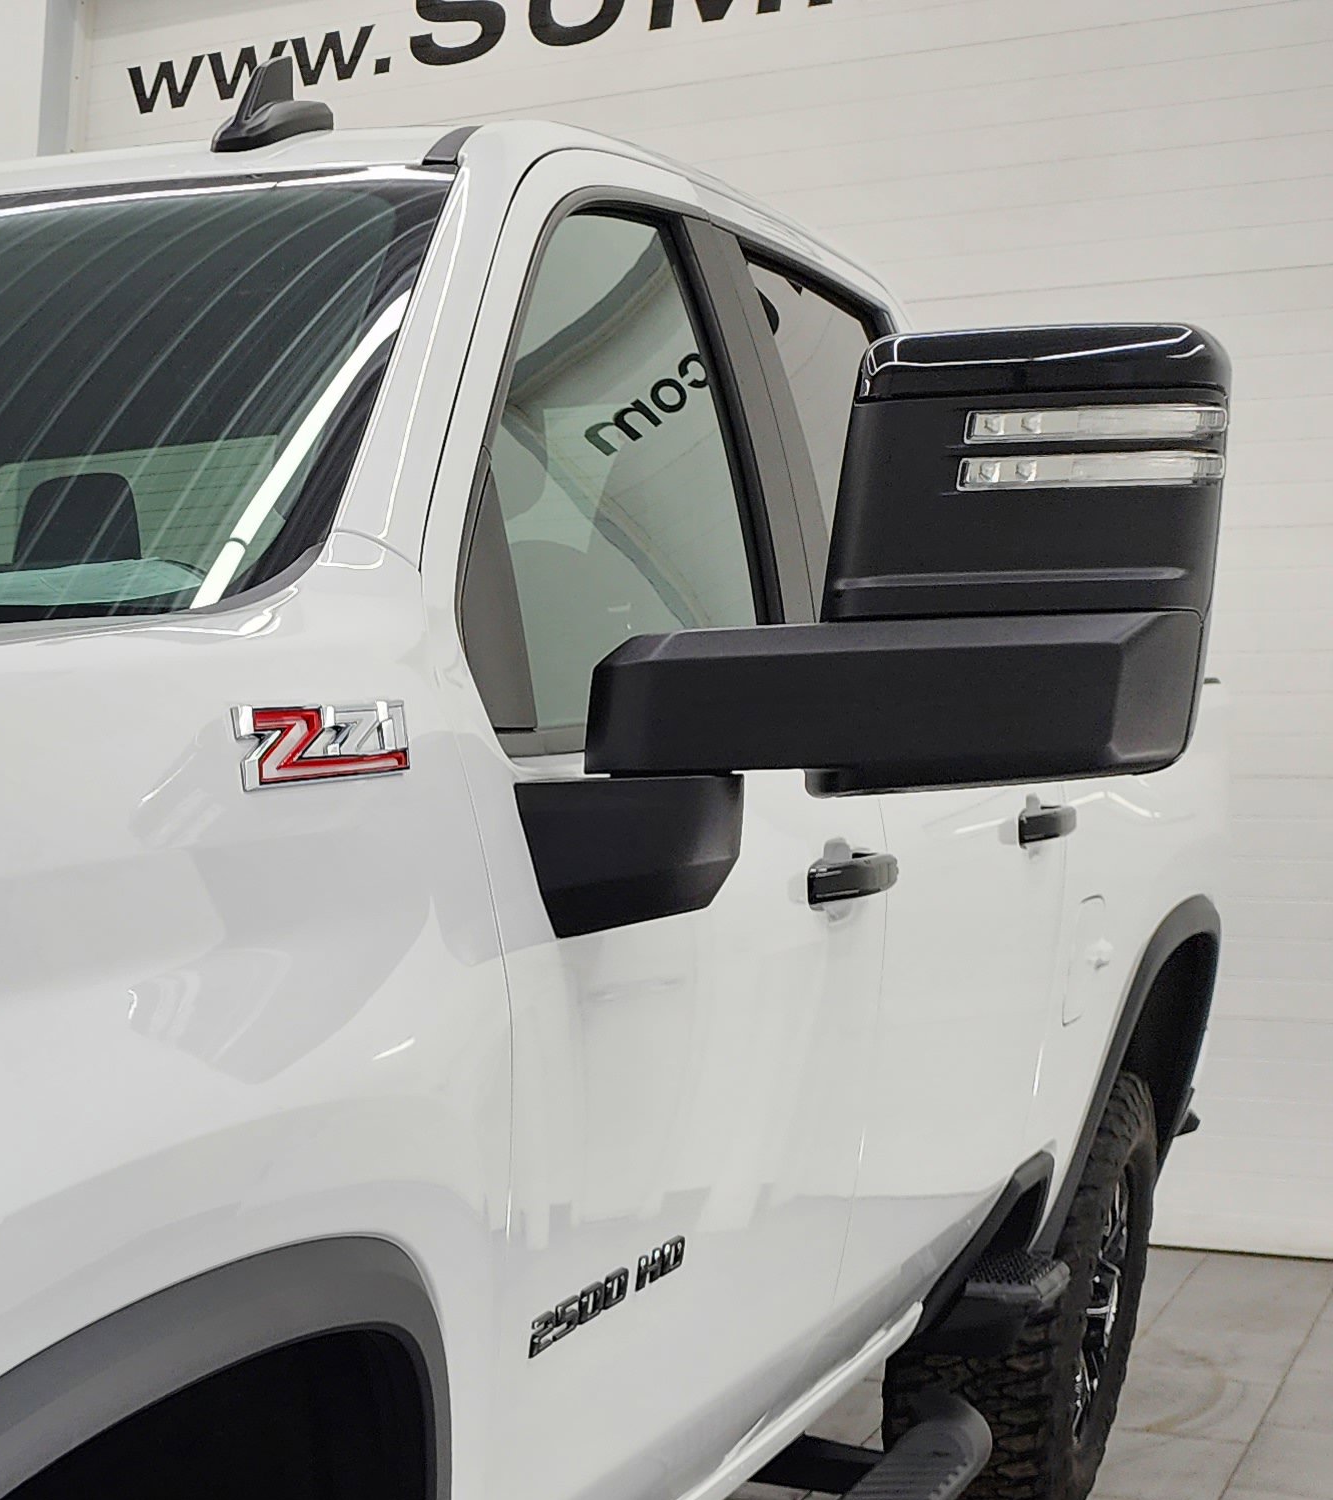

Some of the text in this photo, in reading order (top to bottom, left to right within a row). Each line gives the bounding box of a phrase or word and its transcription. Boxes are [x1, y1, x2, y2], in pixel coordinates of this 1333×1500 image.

[230, 700, 410, 792] Z71
[528, 1234, 686, 1359] 2500 HD
